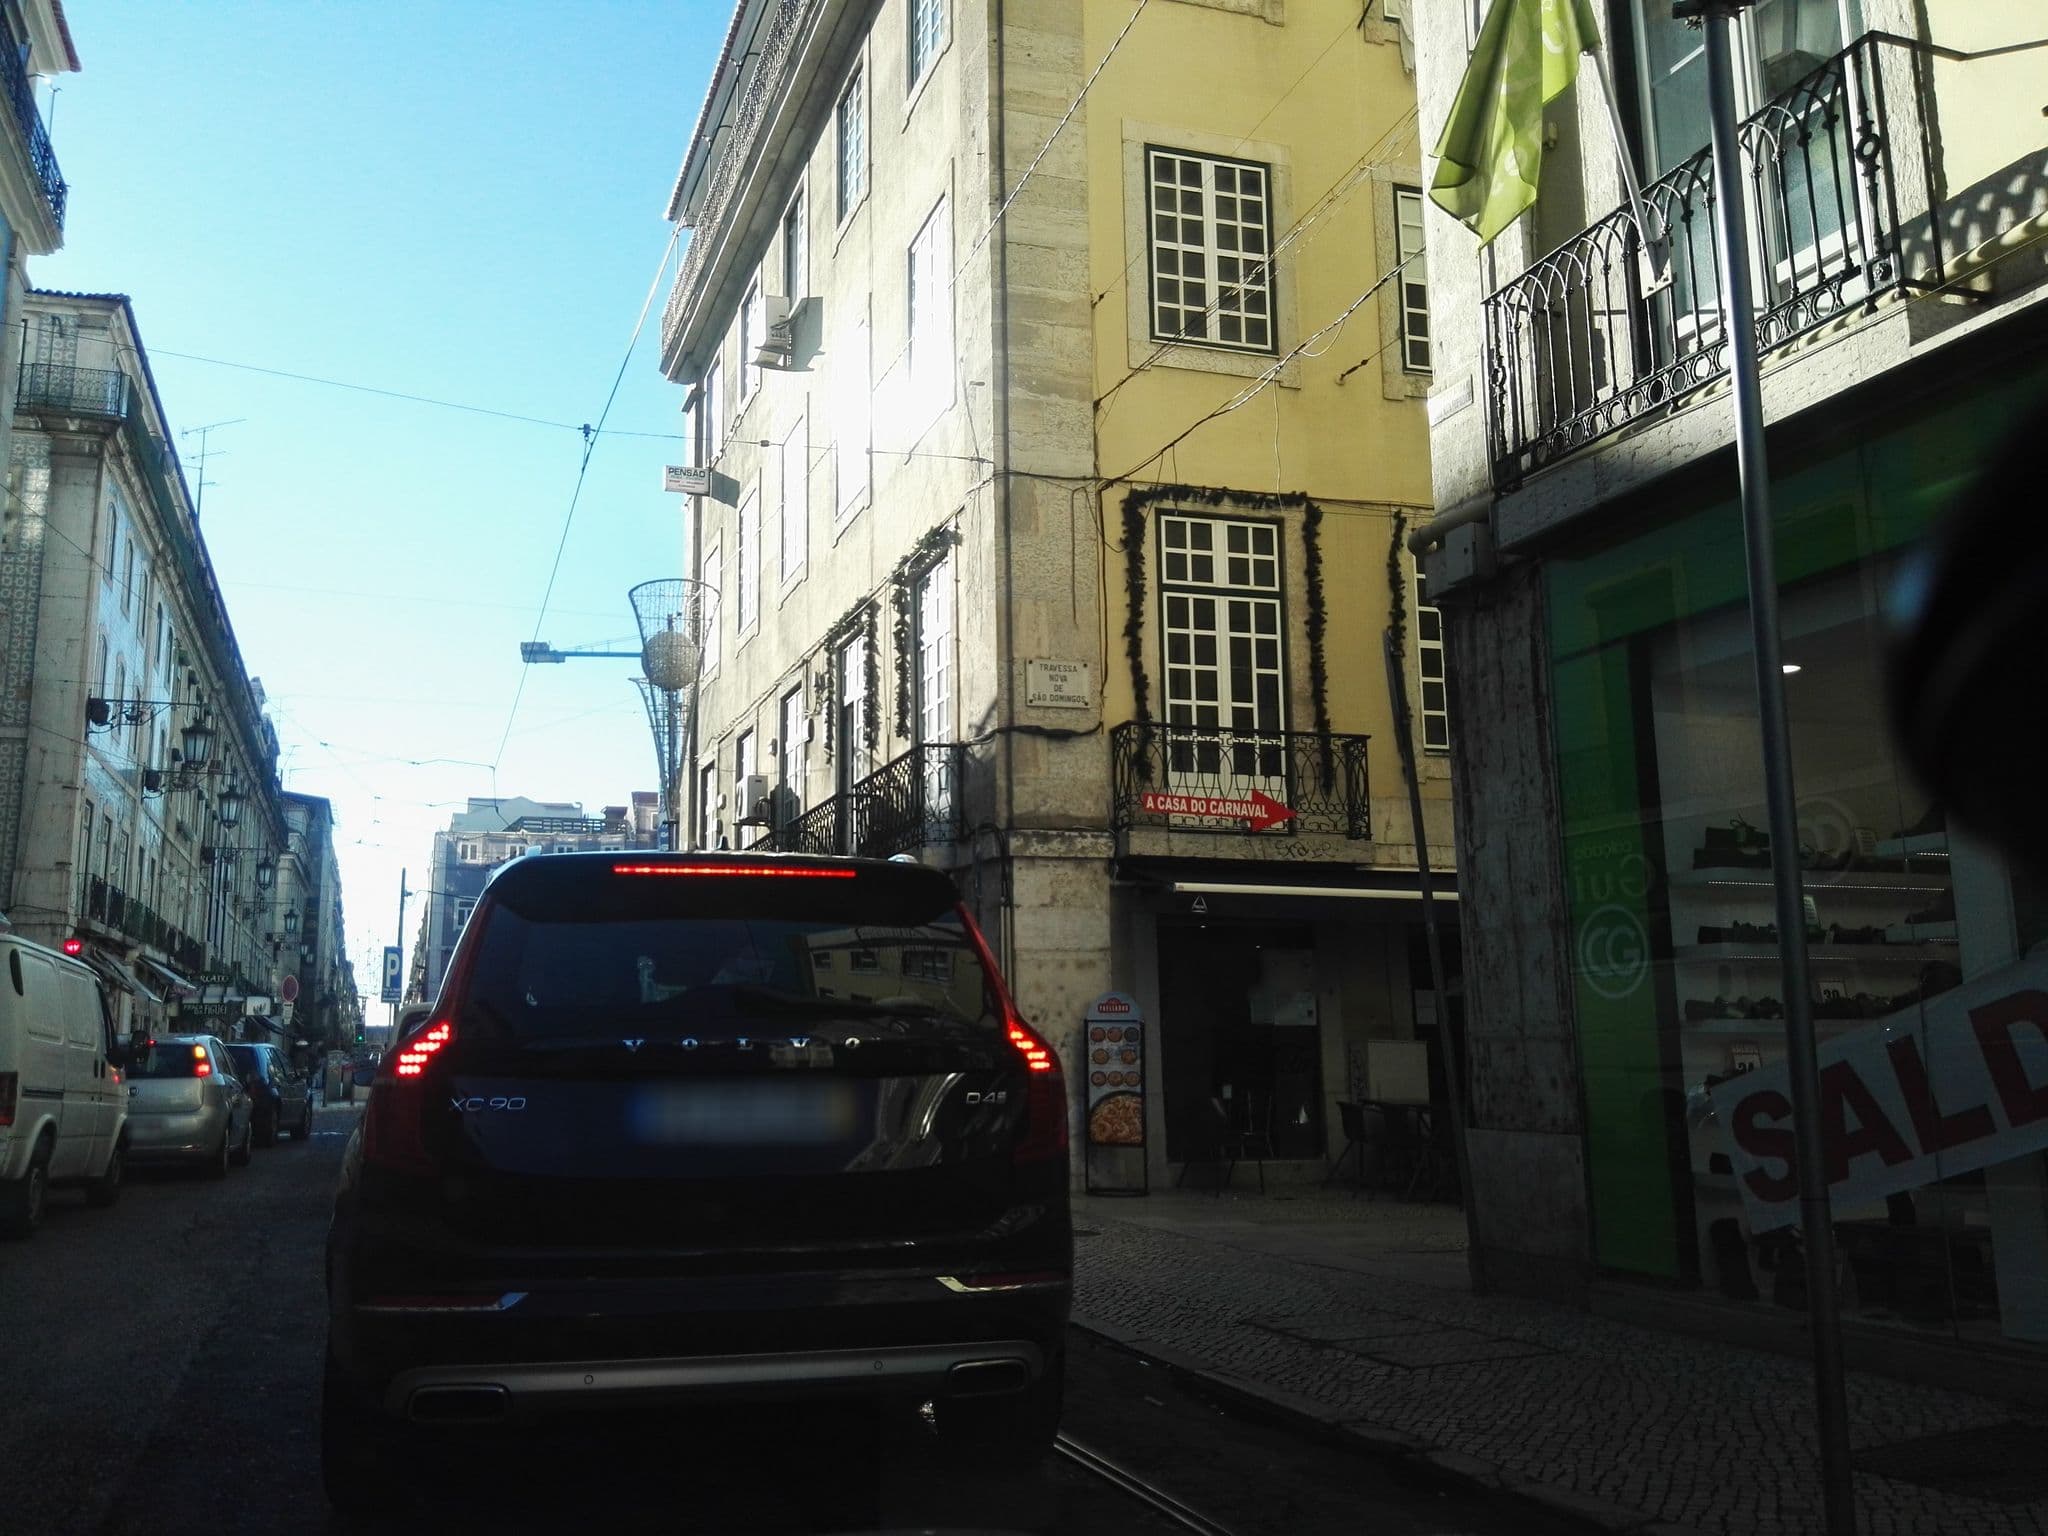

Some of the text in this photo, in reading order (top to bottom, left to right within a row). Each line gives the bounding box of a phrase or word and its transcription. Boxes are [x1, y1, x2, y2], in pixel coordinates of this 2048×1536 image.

[1040, 664, 1078, 672] TRAVESSA
[1054, 684, 1064, 692] DE
[1050, 694, 1087, 704] DOMINGOS
[1146, 796, 1269, 818] A CASA DO CARNAVAL
[386, 953, 400, 987] P
[621, 1036, 861, 1052] VOLVO
